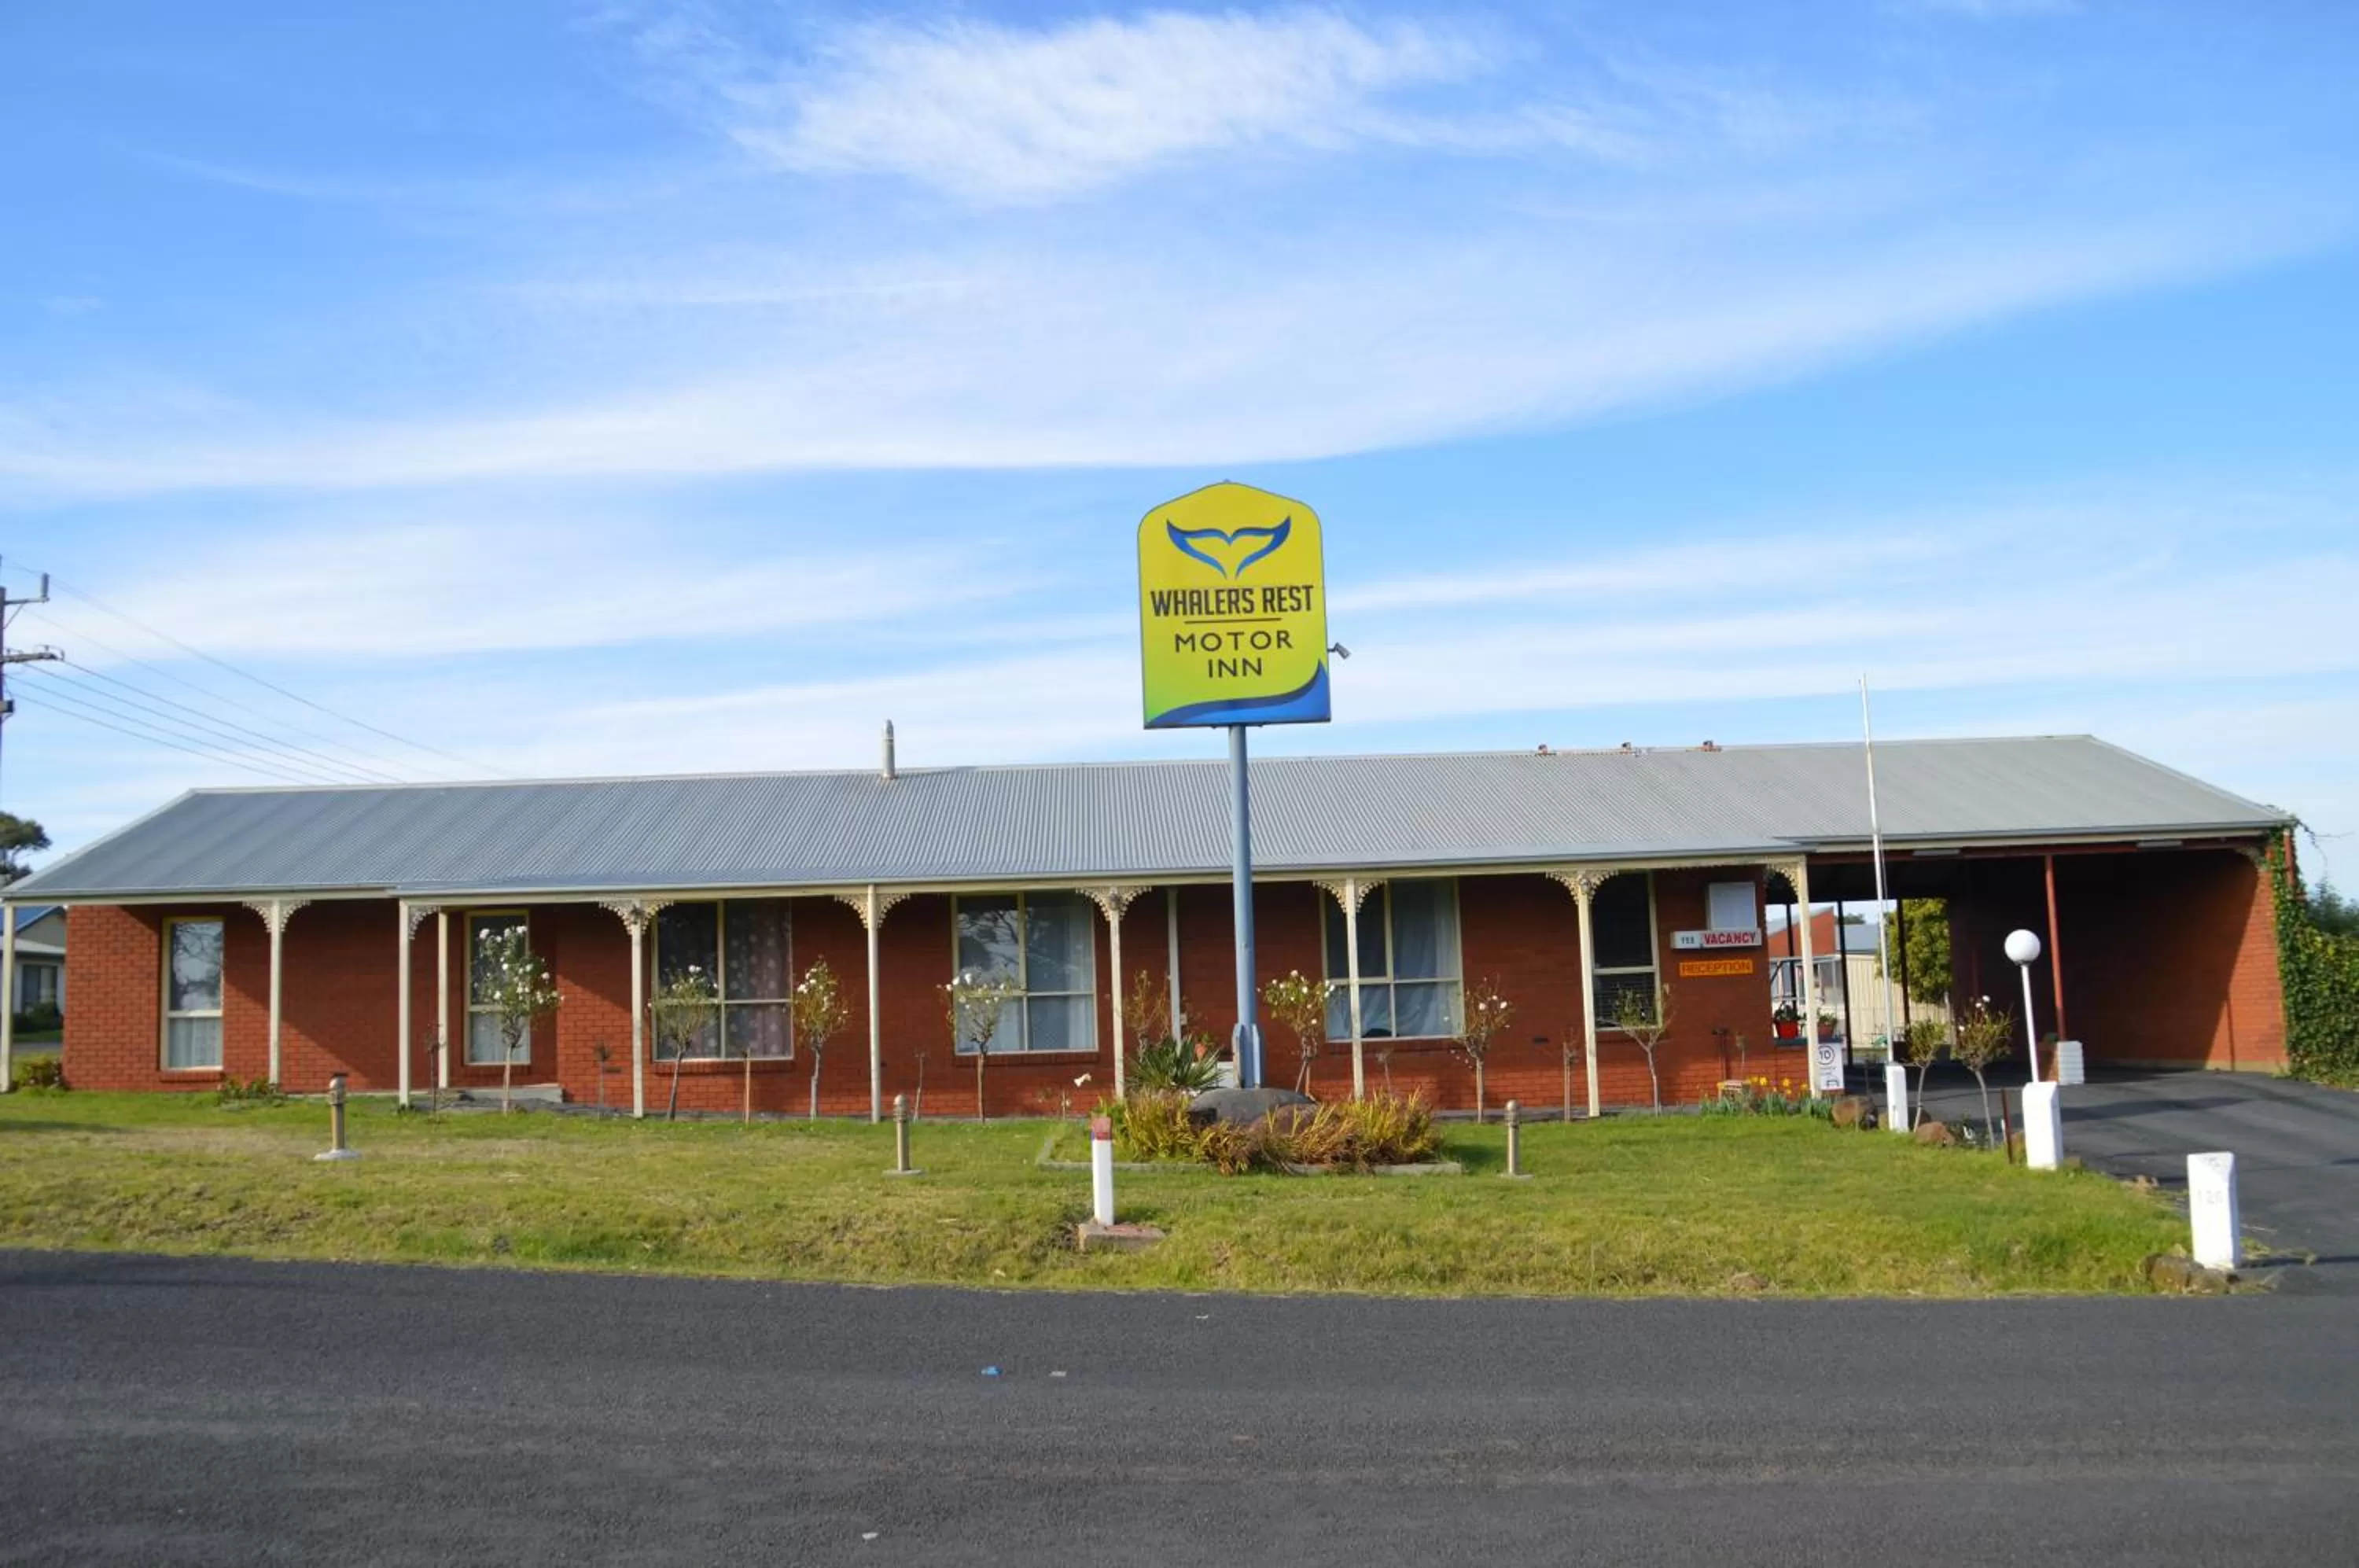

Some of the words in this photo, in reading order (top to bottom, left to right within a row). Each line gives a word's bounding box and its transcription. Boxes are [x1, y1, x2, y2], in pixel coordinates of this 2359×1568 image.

[1150, 588, 1255, 617] WHALERS
[1262, 584, 1314, 613] REST
[1175, 630, 1294, 653] MOTOR
[1208, 657, 1263, 679] INN
[1704, 932, 1756, 945] VACANCY
[1682, 961, 1750, 975] RECEPTION
[1819, 1050, 1831, 1060] 10
